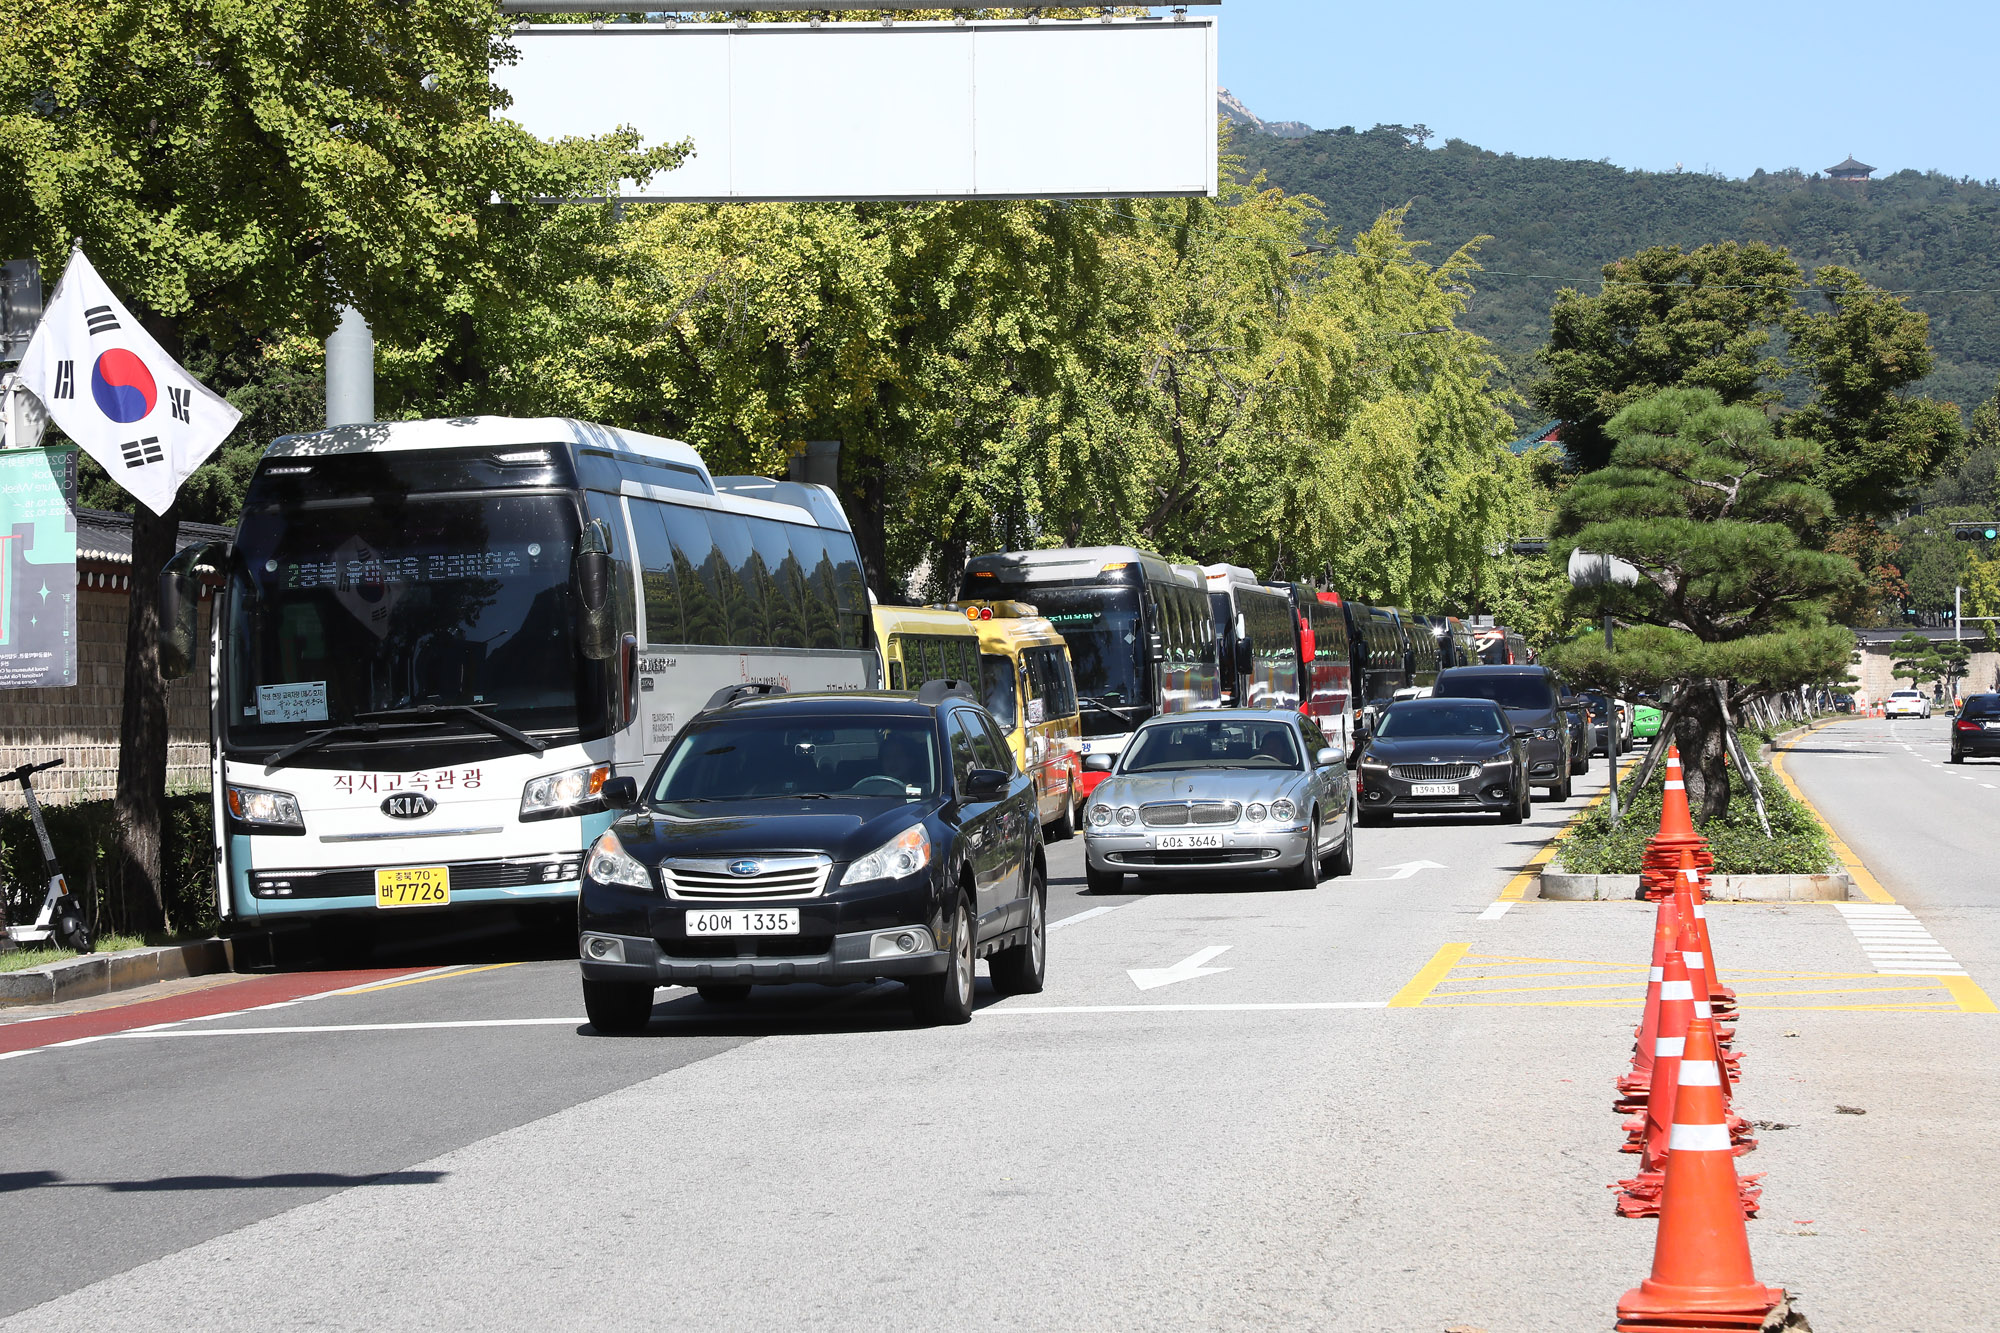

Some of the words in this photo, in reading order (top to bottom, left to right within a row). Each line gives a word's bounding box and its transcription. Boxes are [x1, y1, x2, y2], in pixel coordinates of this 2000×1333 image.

[333, 768, 484, 794] 직지고속관광
[389, 797, 428, 814] KIA
[1189, 836, 1216, 847] 3646
[396, 872, 412, 881] 충북
[415, 870, 430, 880] 70
[742, 913, 788, 930] 1335
